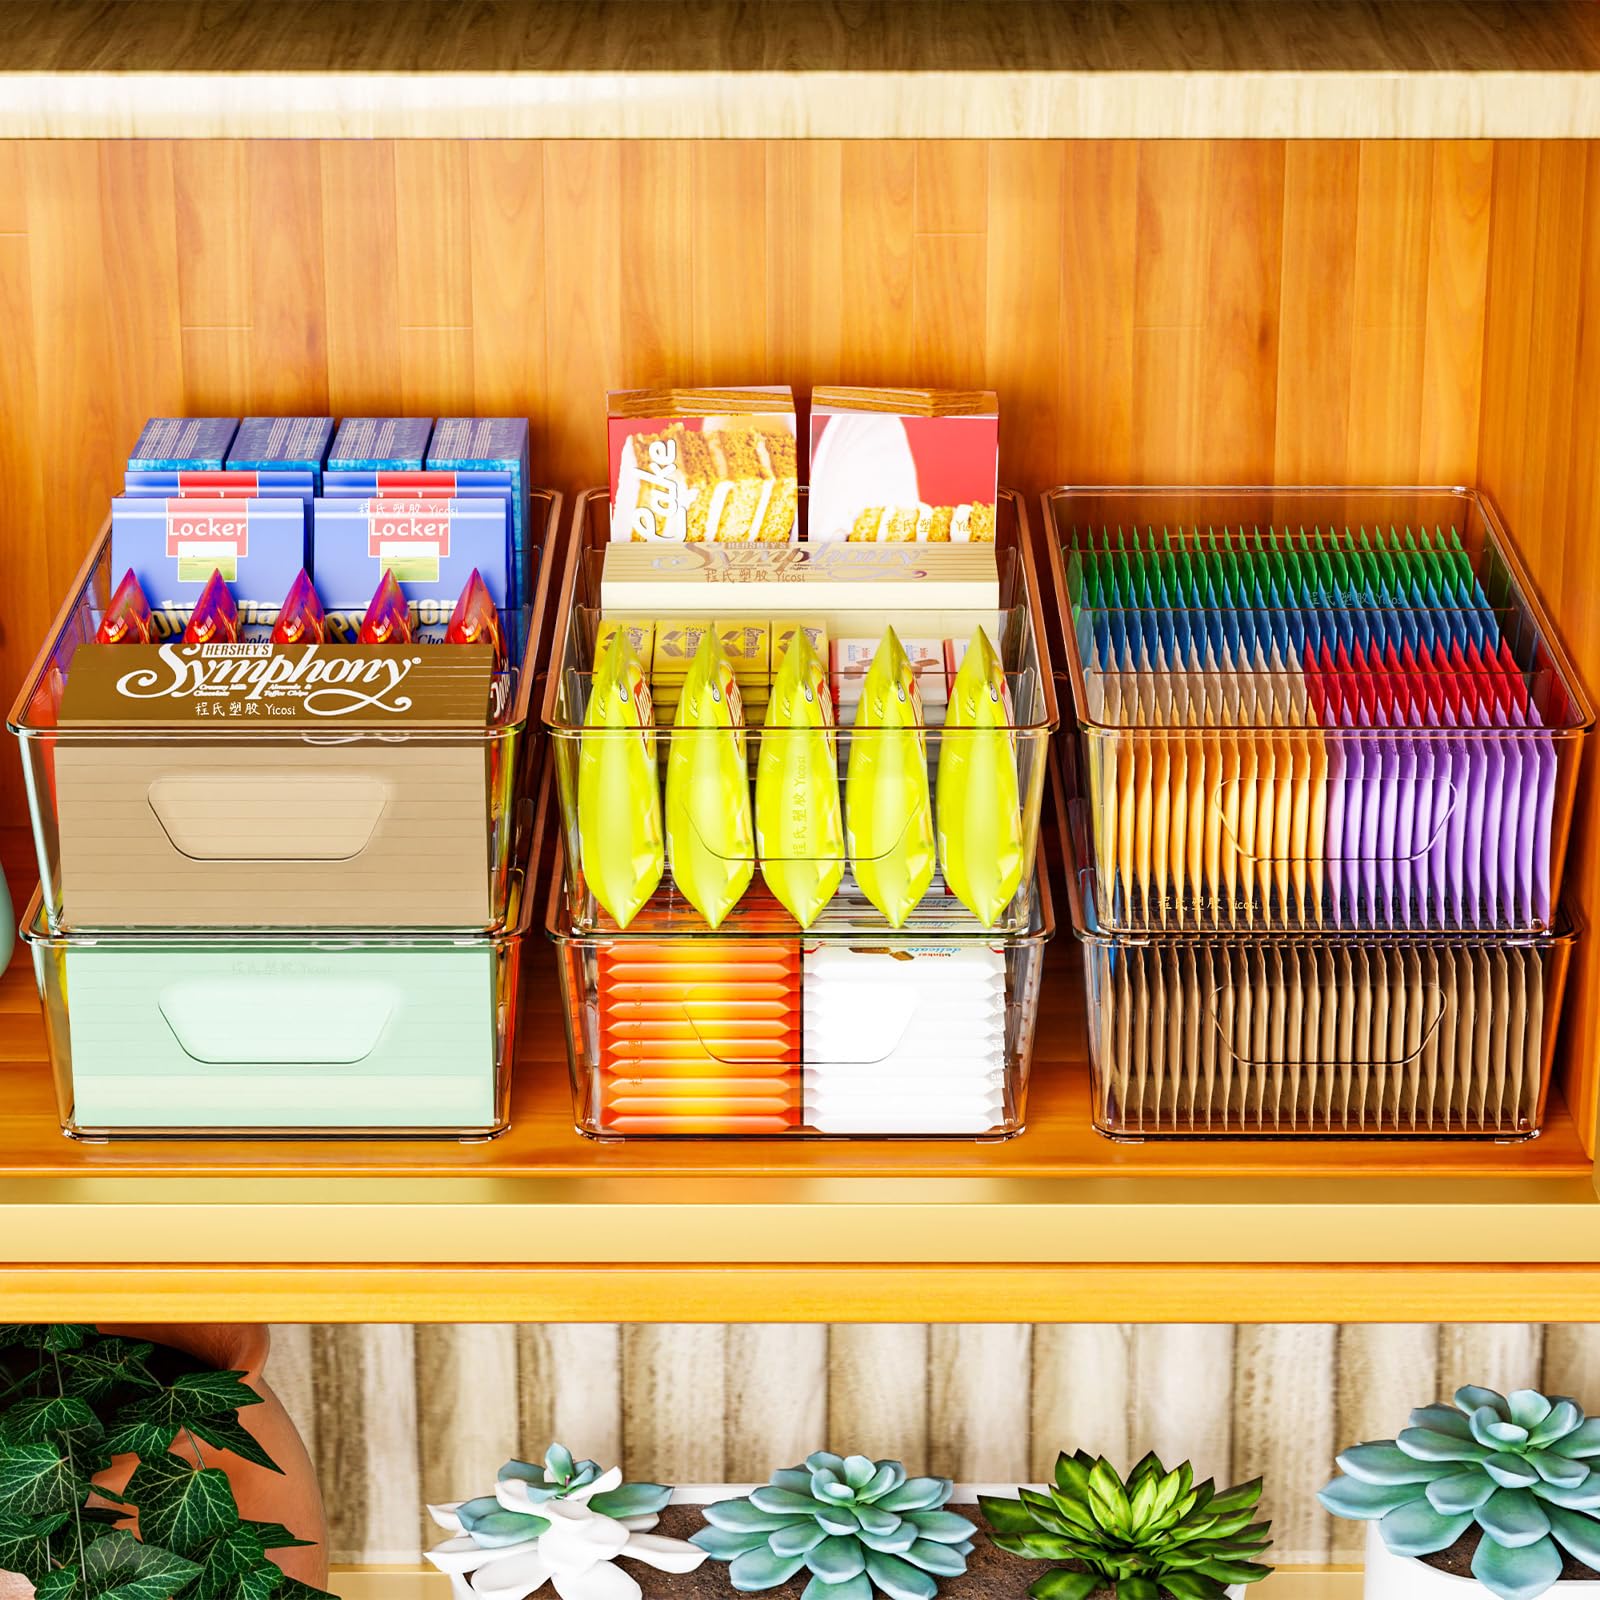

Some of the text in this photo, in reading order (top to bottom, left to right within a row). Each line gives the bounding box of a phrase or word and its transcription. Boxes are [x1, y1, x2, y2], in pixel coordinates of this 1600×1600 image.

[168, 517, 247, 536] Locker
[370, 517, 449, 536] Locker
[204, 643, 272, 656] HERSHEY'S
[116, 643, 412, 717] Symphony
